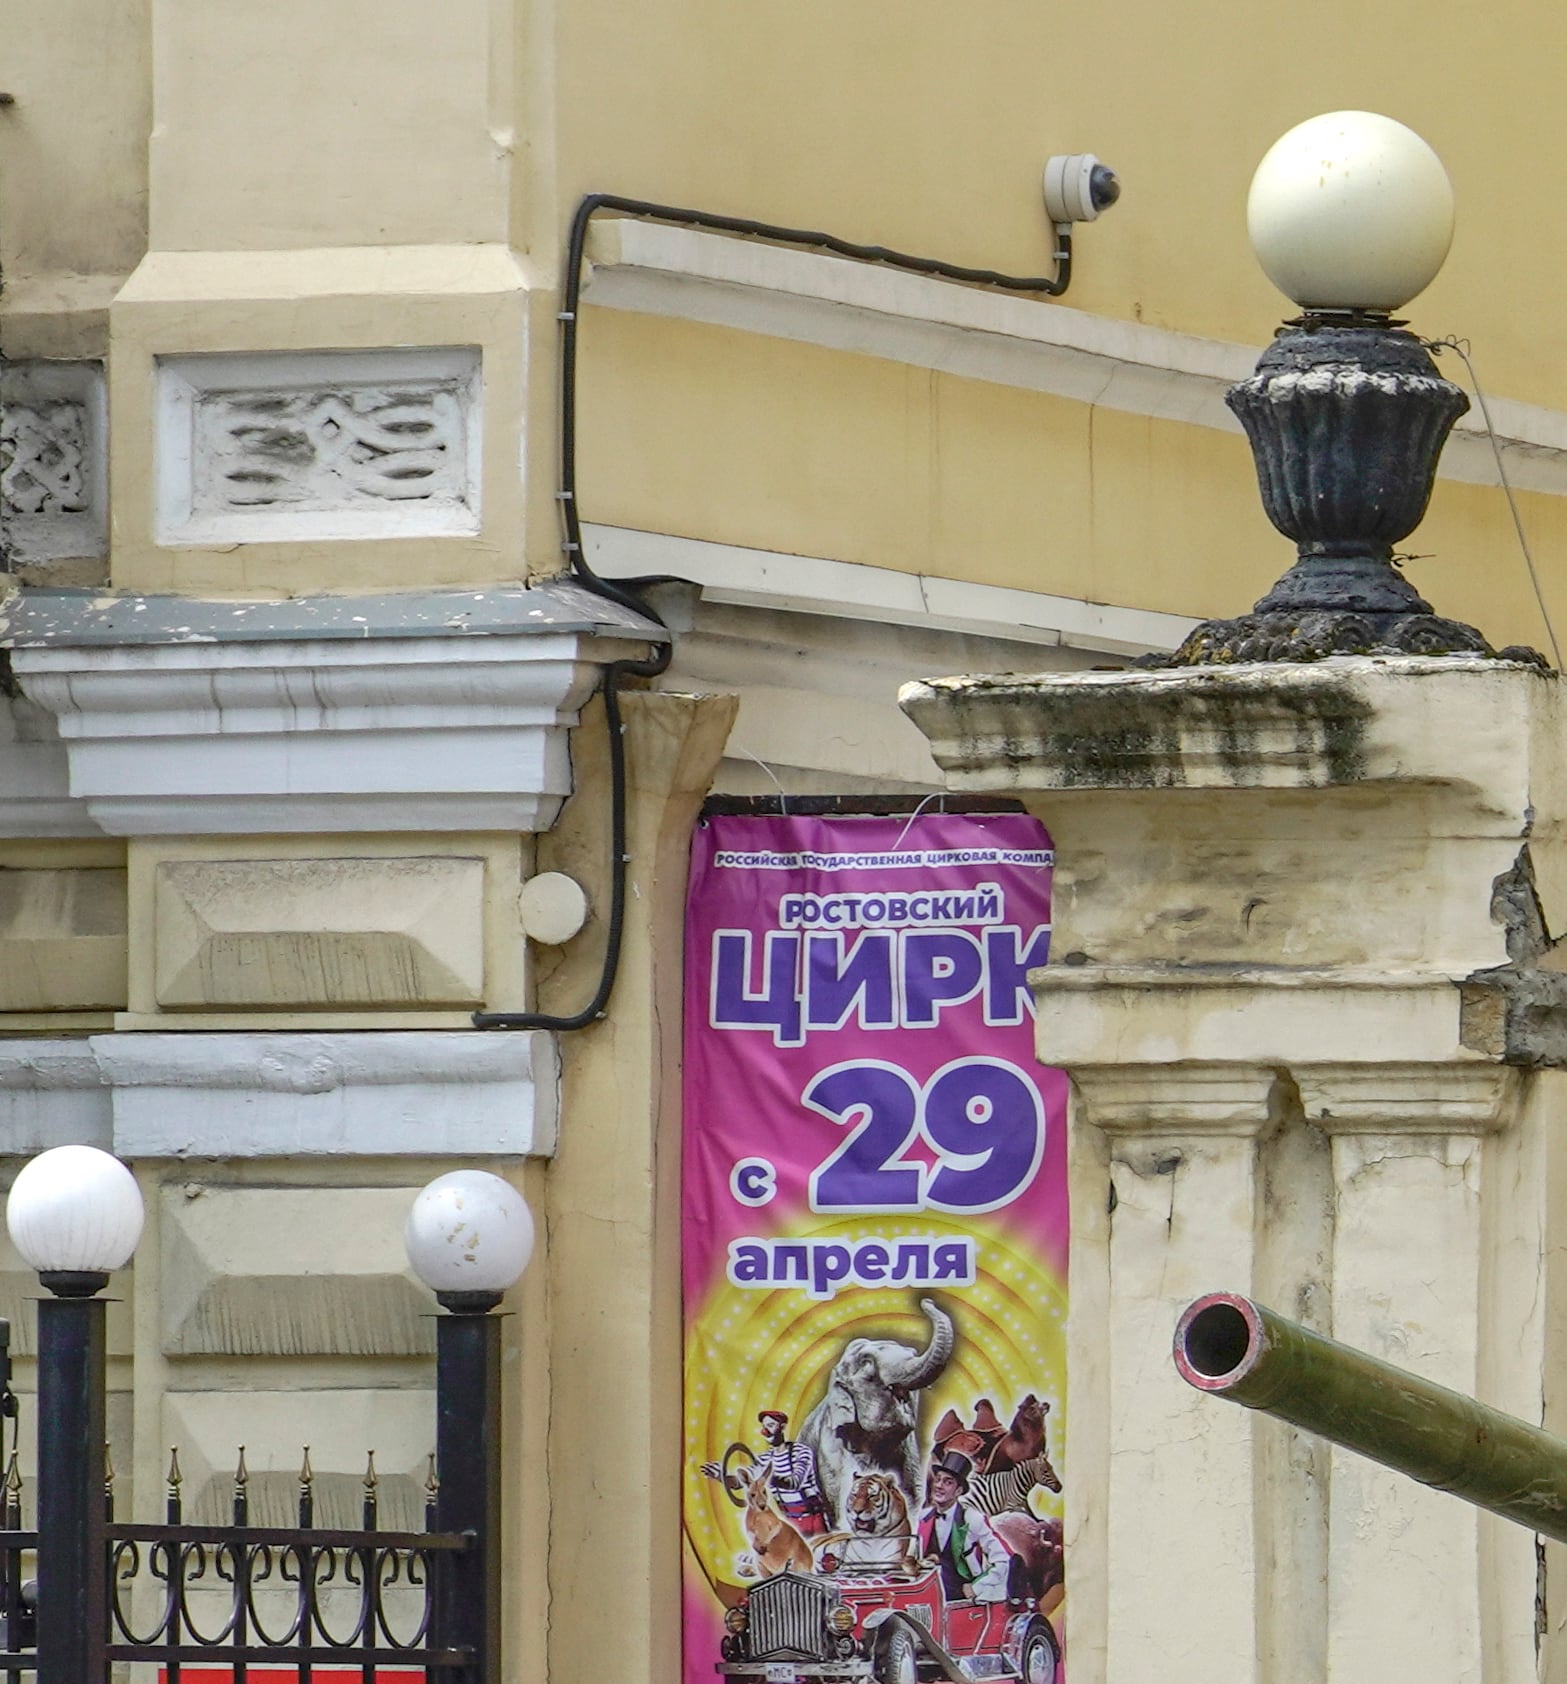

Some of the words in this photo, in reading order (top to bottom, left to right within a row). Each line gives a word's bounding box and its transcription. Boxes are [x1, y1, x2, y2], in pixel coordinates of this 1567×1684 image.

[717, 853, 798, 866] РОССИЙСКАЯ
[802, 854, 921, 867] ГОСУДАРСТВЕННАЯ
[927, 851, 997, 865] ЦИРКОВАЯ
[1003, 852, 1055, 863] КОМПА
[785, 888, 998, 924] РОСТОВСКИЙ
[716, 930, 1051, 1042] ЦИРК
[737, 1165, 772, 1199] с
[808, 1063, 1038, 1207] 29
[733, 1243, 968, 1293] апреля
